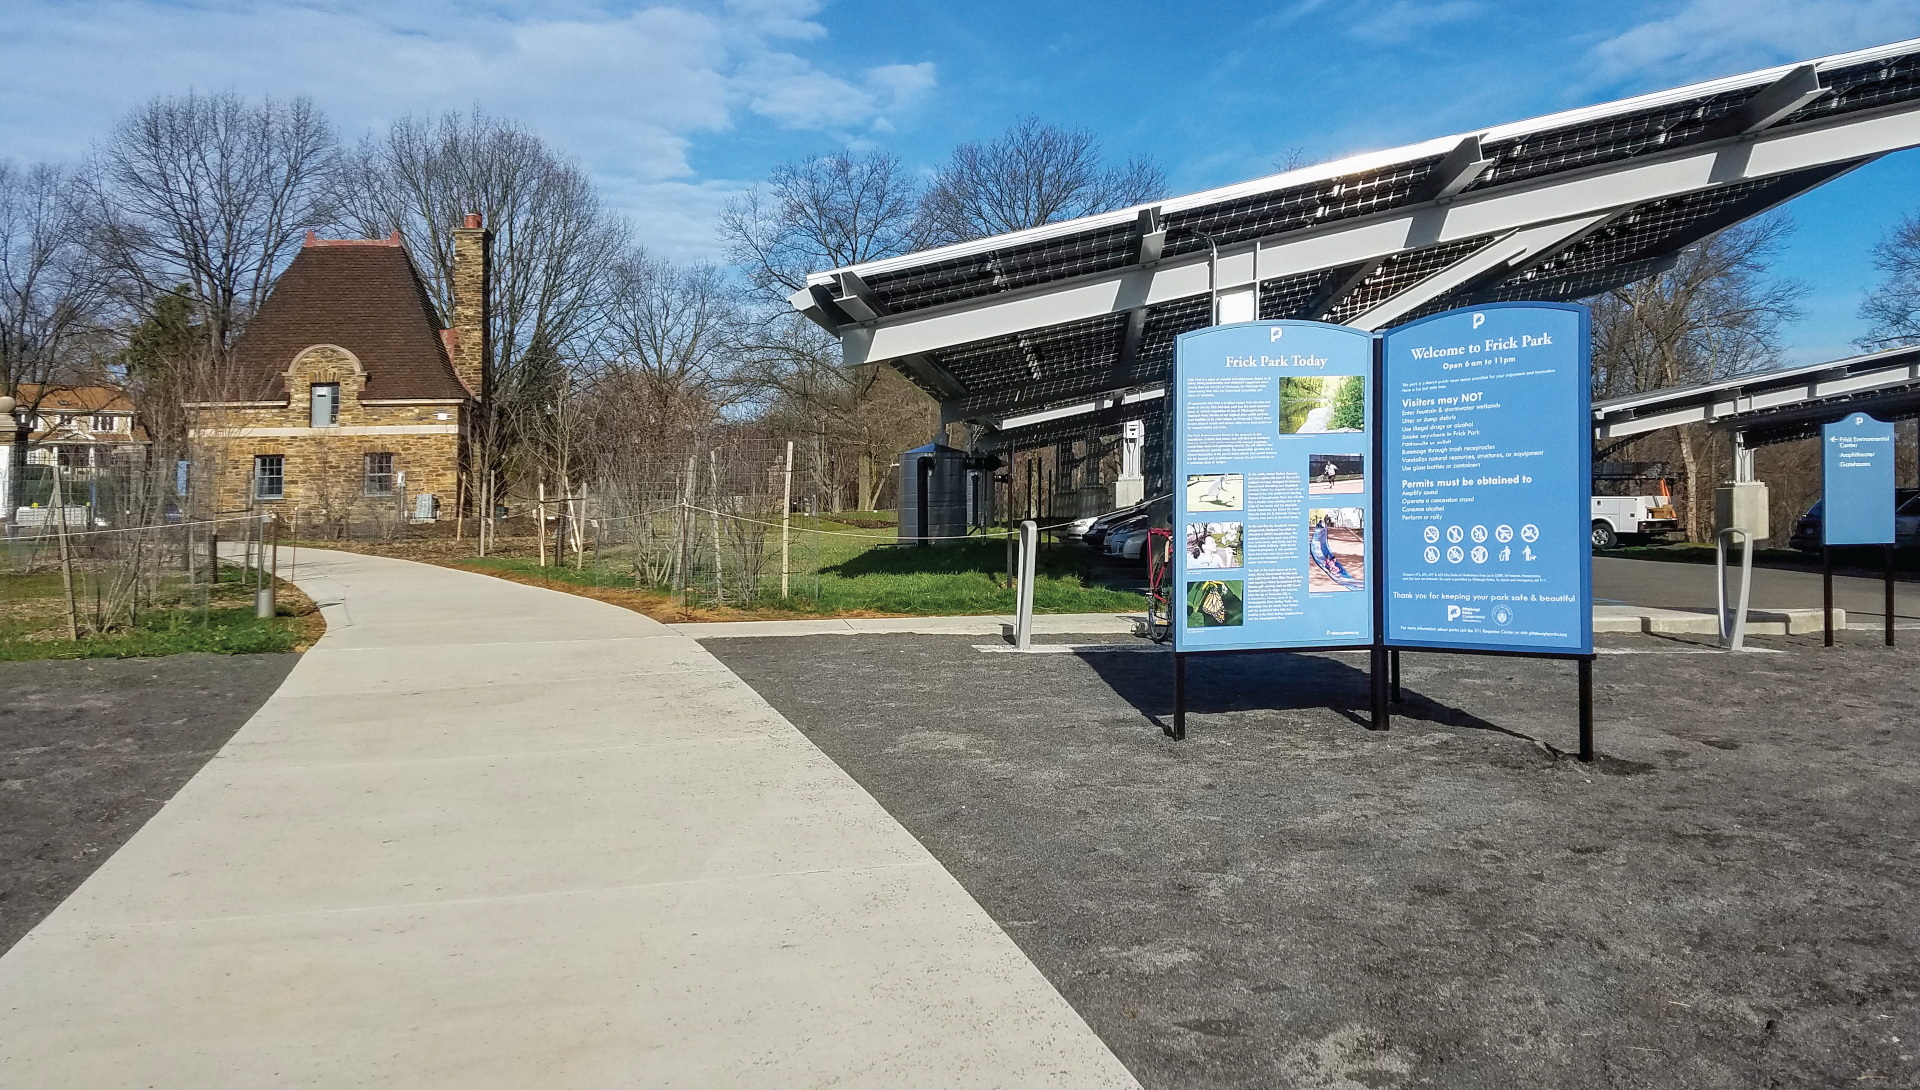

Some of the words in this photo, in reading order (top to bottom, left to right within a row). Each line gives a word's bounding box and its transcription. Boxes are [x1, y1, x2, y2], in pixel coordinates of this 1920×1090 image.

[1411, 346, 1465, 360] Welcome
[1469, 344, 1480, 353] to
[1485, 337, 1518, 351] Frick
[1522, 332, 1553, 348] Park
[1226, 356, 1257, 367] Frick
[1261, 355, 1289, 366] Park
[1291, 355, 1328, 370] Today
[1443, 362, 1462, 370] Open
[1495, 357, 1515, 365] 11pm
[1402, 399, 1435, 407] Visitors
[1462, 392, 1483, 402] NOT
[1402, 479, 1434, 488] Permits
[1462, 477, 1474, 486] be
[1477, 475, 1519, 485] obtained
[1442, 593, 1470, 601] keeping
